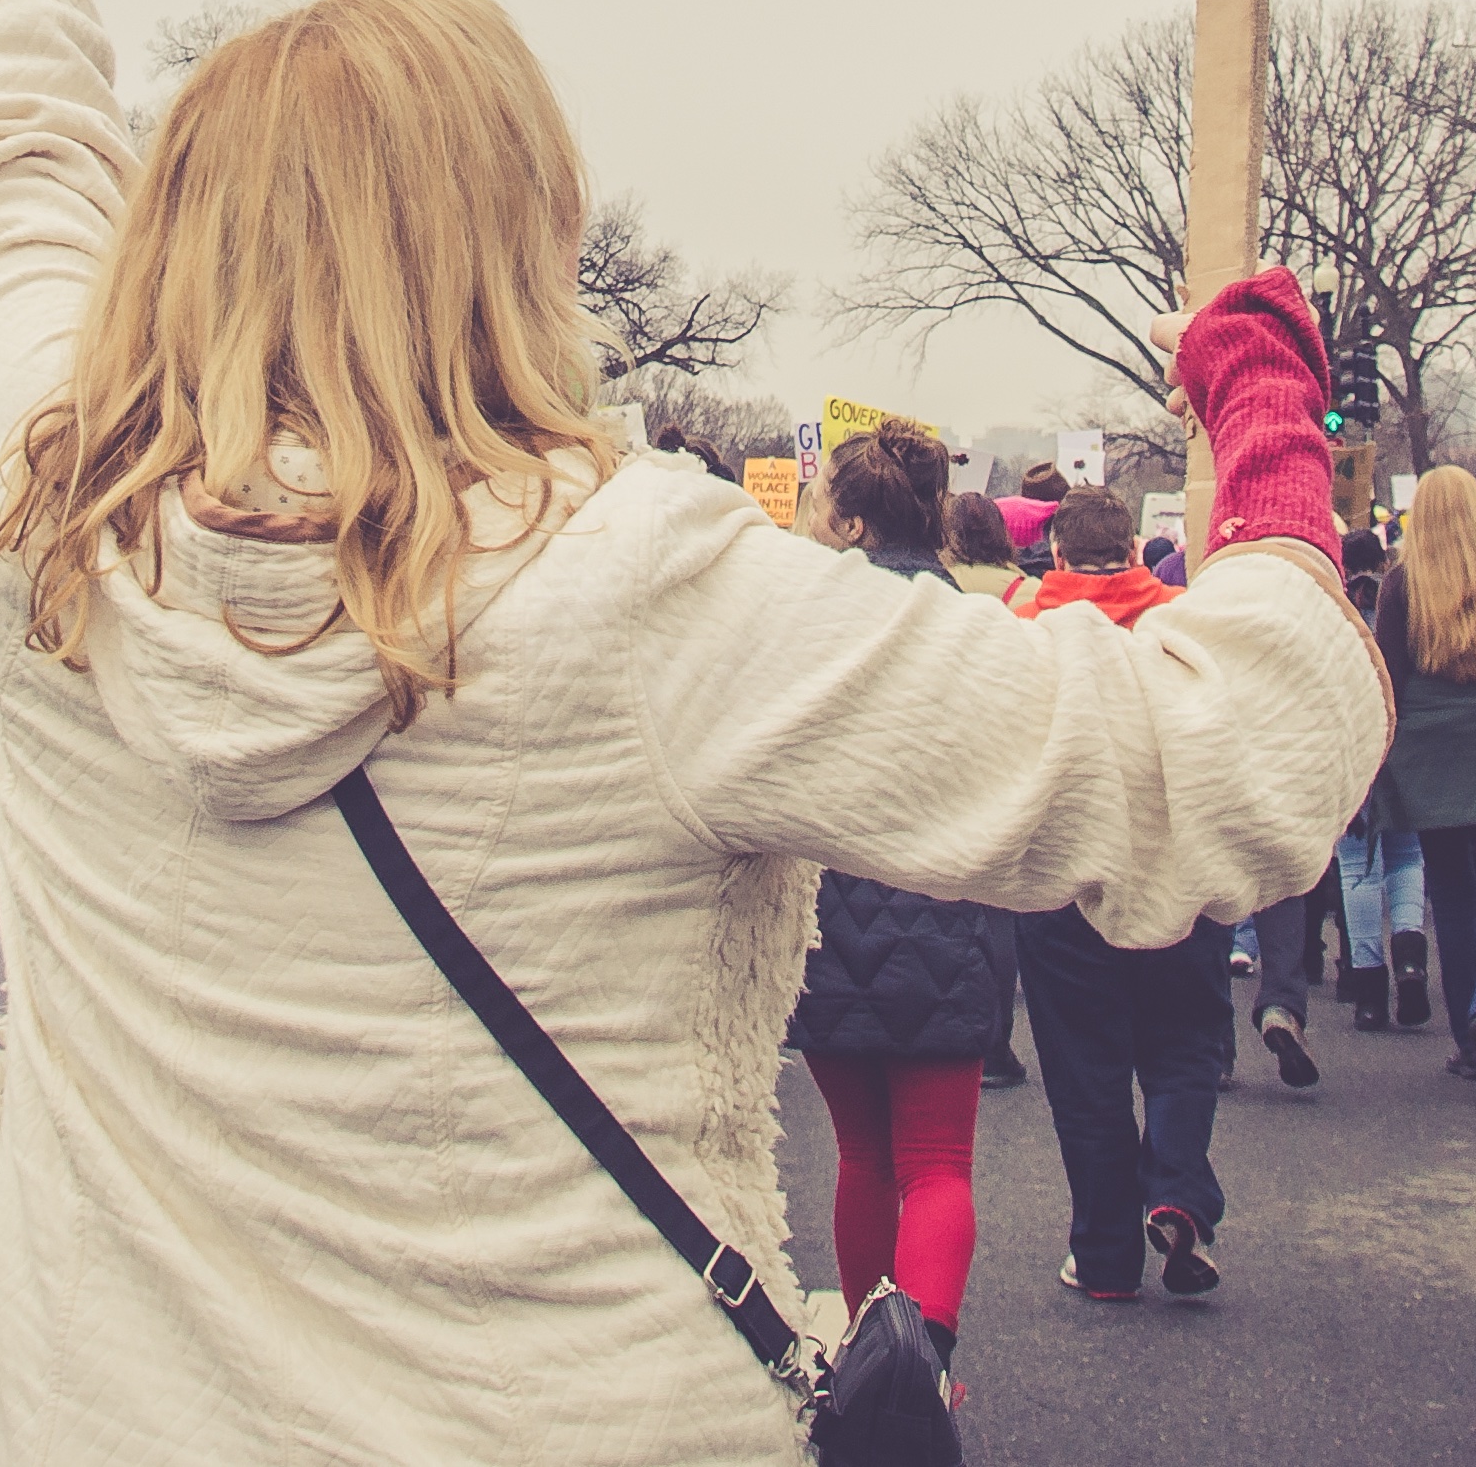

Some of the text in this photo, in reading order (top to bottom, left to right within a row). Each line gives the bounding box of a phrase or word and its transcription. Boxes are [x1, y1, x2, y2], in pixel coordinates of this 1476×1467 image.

[769, 460, 777, 470] A
[747, 471, 797, 482] WOMAN'S
[752, 482, 790, 494] PLACE
[773, 499, 794, 510] THE
